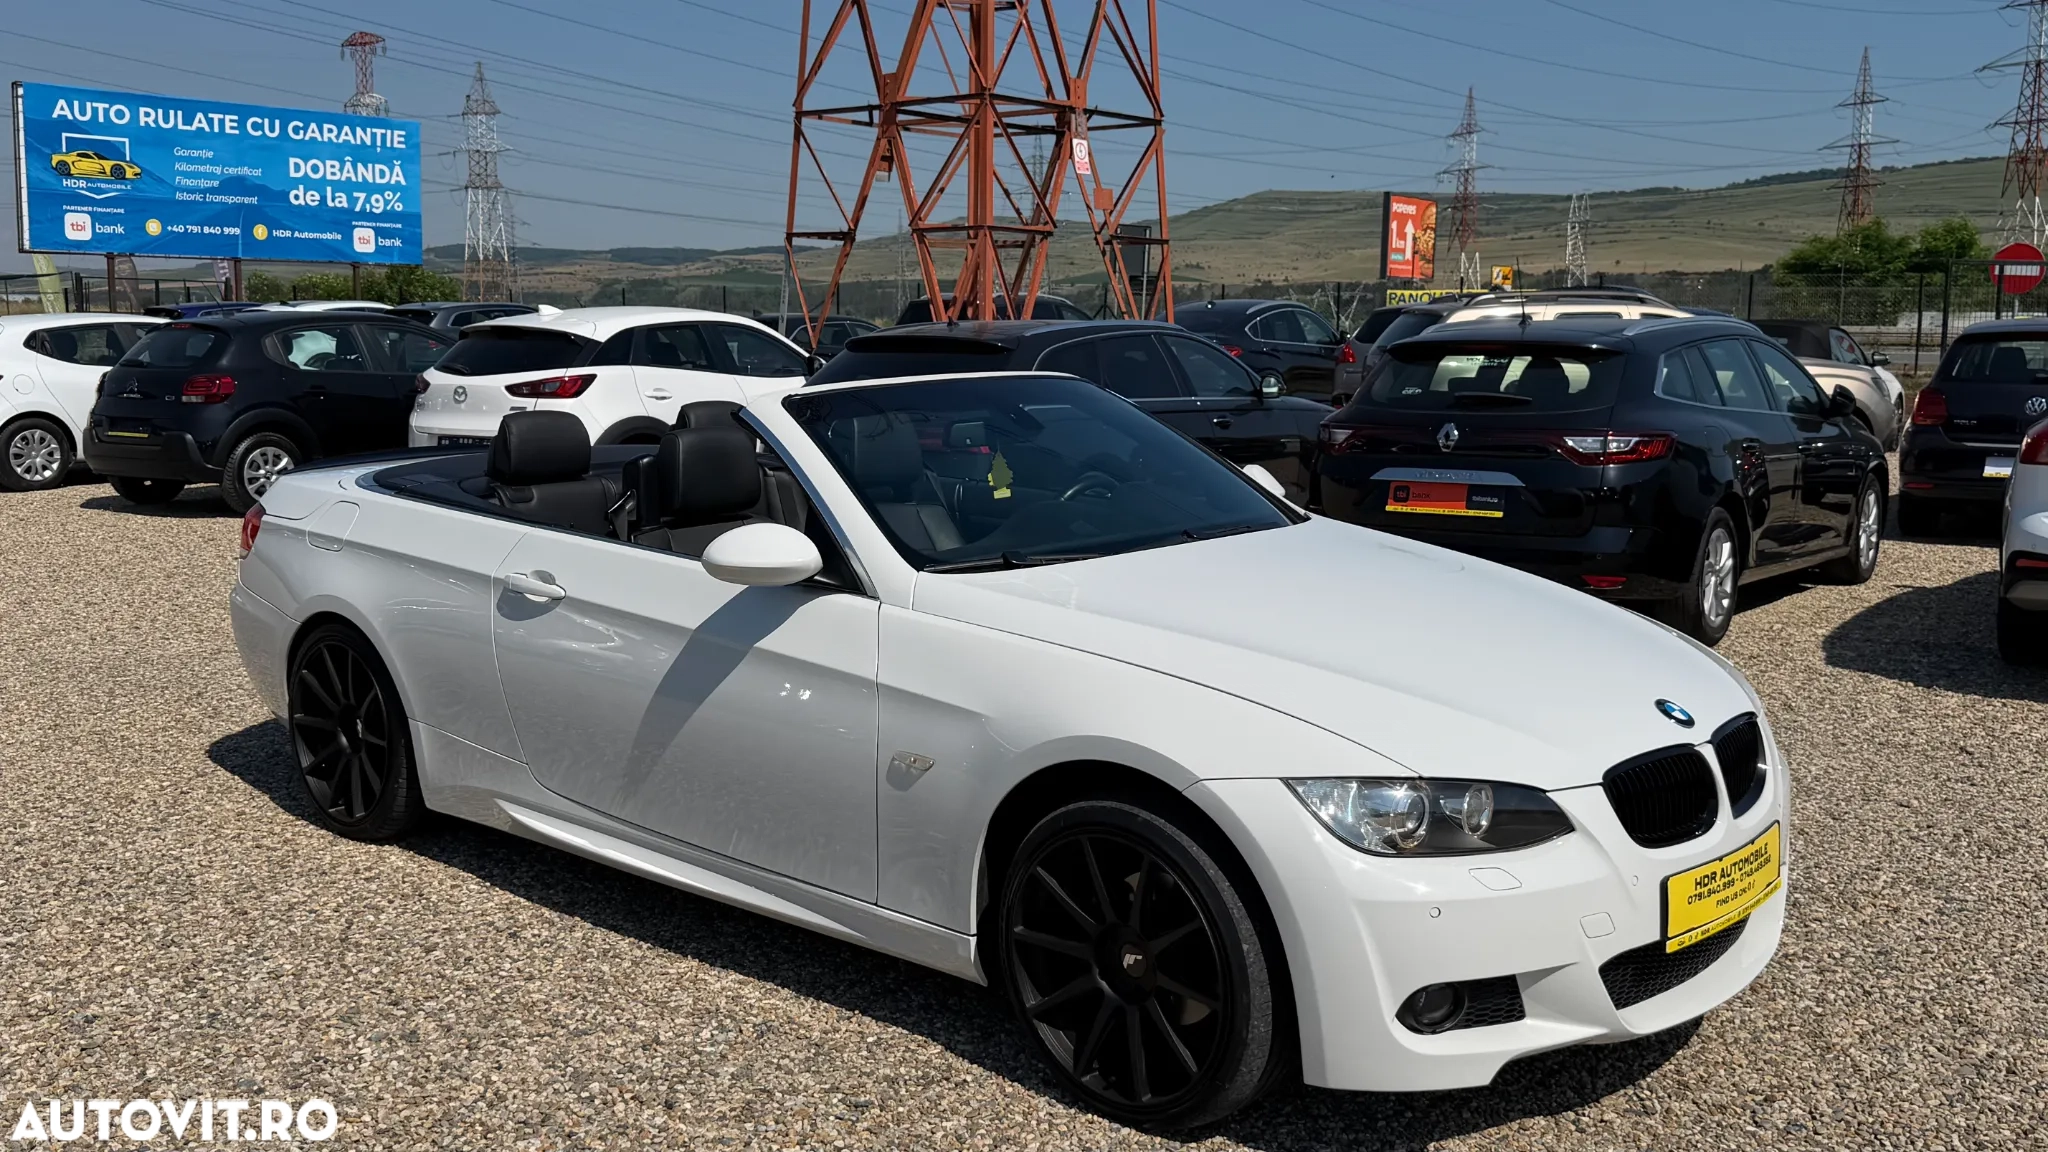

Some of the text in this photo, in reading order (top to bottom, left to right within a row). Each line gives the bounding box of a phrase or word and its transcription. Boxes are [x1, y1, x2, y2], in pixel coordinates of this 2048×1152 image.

[52, 99, 406, 152] AUTO RULATE CU GARANȚIE
[174, 147, 214, 159] Garanție
[175, 162, 262, 177] Kilometraj certificat
[289, 156, 406, 185] DOBÂNDĂ
[63, 178, 132, 190] HDR AUTOMOBILE
[175, 176, 220, 188] Finanțare
[176, 191, 258, 205] Istoric transparent
[289, 185, 403, 214] de la 7,9%
[70, 221, 125, 234] tbi bank
[167, 225, 184, 233] +40
[204, 226, 221, 234] 840
[223, 227, 240, 235] 999
[273, 229, 342, 240] HDR Automobile
[358, 235, 402, 247] tbi bank
[1695, 842, 1768, 891] HDR AUTOMOBILE
[1716, 896, 1730, 908] FIND
[1731, 891, 1738, 901] US
